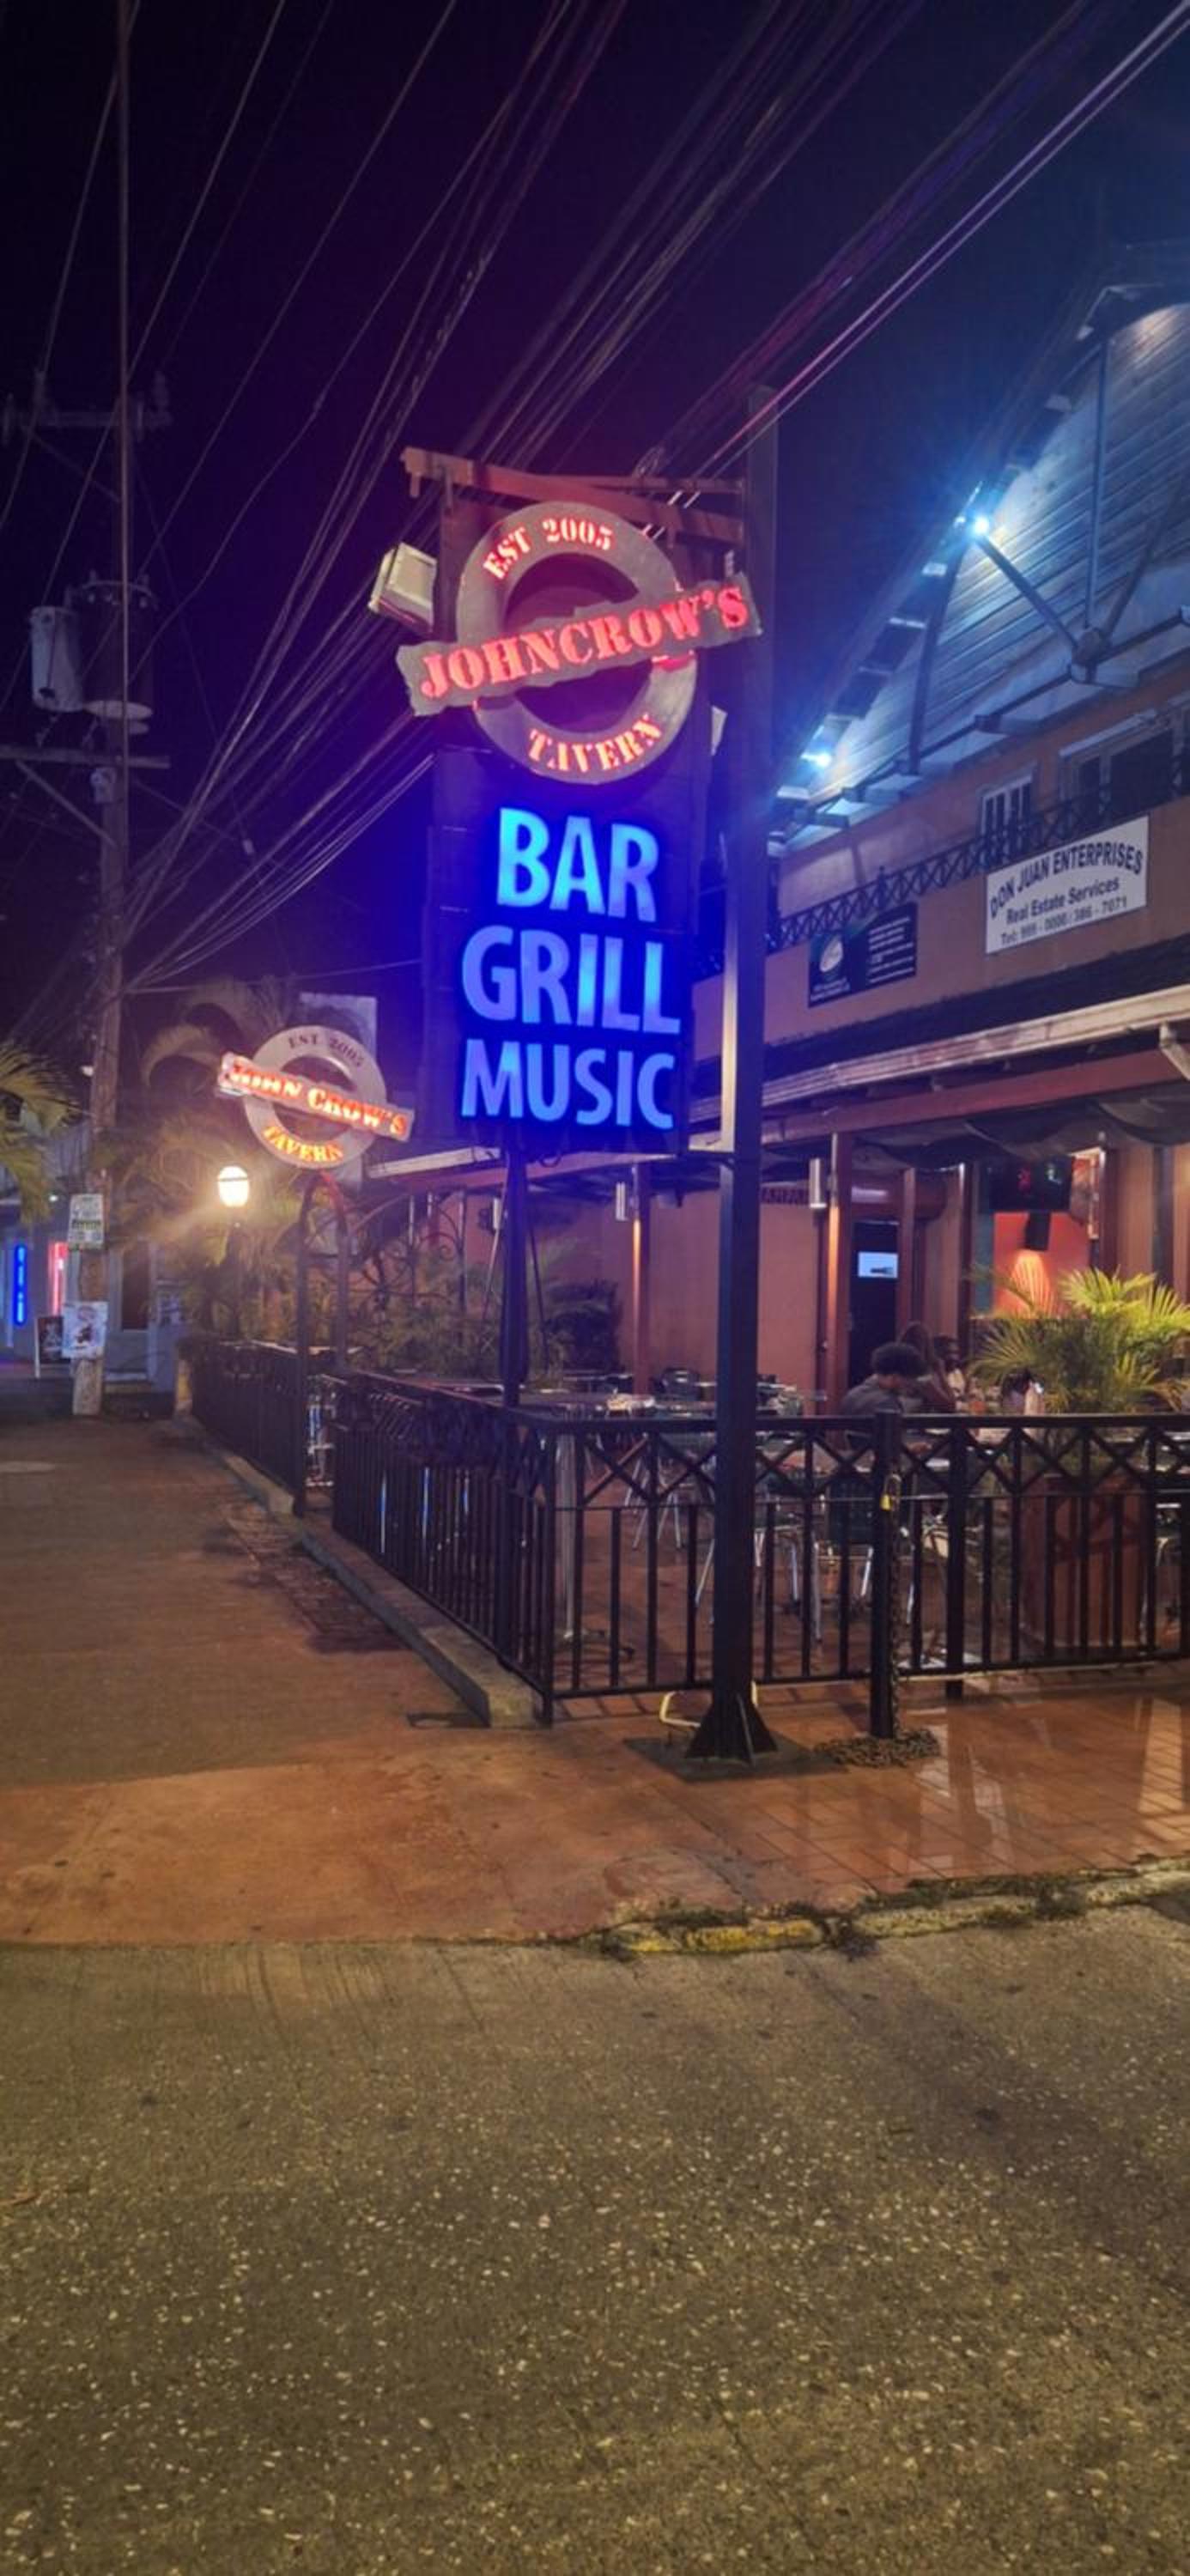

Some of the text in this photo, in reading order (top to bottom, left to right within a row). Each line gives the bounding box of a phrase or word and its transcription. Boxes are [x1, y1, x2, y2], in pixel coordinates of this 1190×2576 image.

[483, 518, 613, 579] EST 2005
[421, 585, 749, 697] JOHNCROW'S
[529, 714, 662, 772] TAVERN
[496, 807, 659, 922] BAR
[990, 841, 1144, 919] DON JUAN ENTERPRISES
[1006, 903, 1029, 926] Real
[1030, 895, 1066, 916] Estate
[1068, 877, 1120, 904] Services
[462, 925, 681, 1034] GRILL
[288, 1033, 317, 1049] EST
[461, 1038, 674, 1130] MUSIC
[264, 1126, 343, 1162] TAVERN
